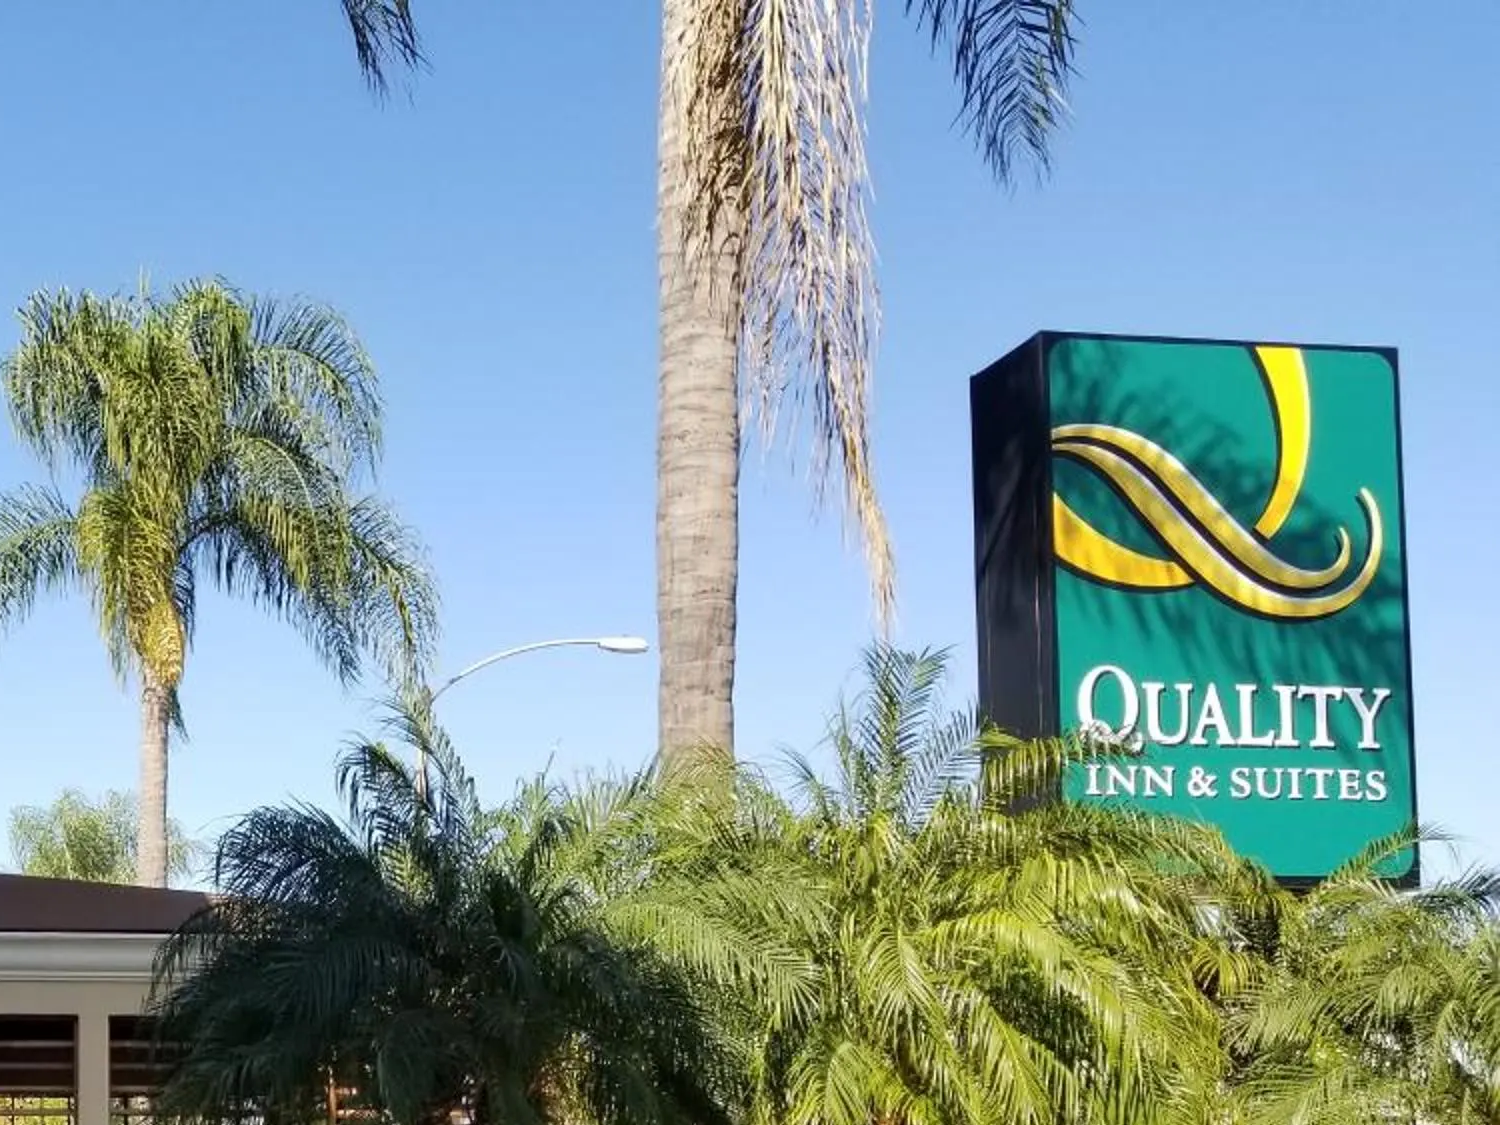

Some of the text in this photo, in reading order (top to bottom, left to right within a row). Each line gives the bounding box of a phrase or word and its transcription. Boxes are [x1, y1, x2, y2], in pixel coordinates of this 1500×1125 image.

[1077, 665, 1391, 752] QUALITY
[1084, 764, 1388, 800] INN & SUITES
